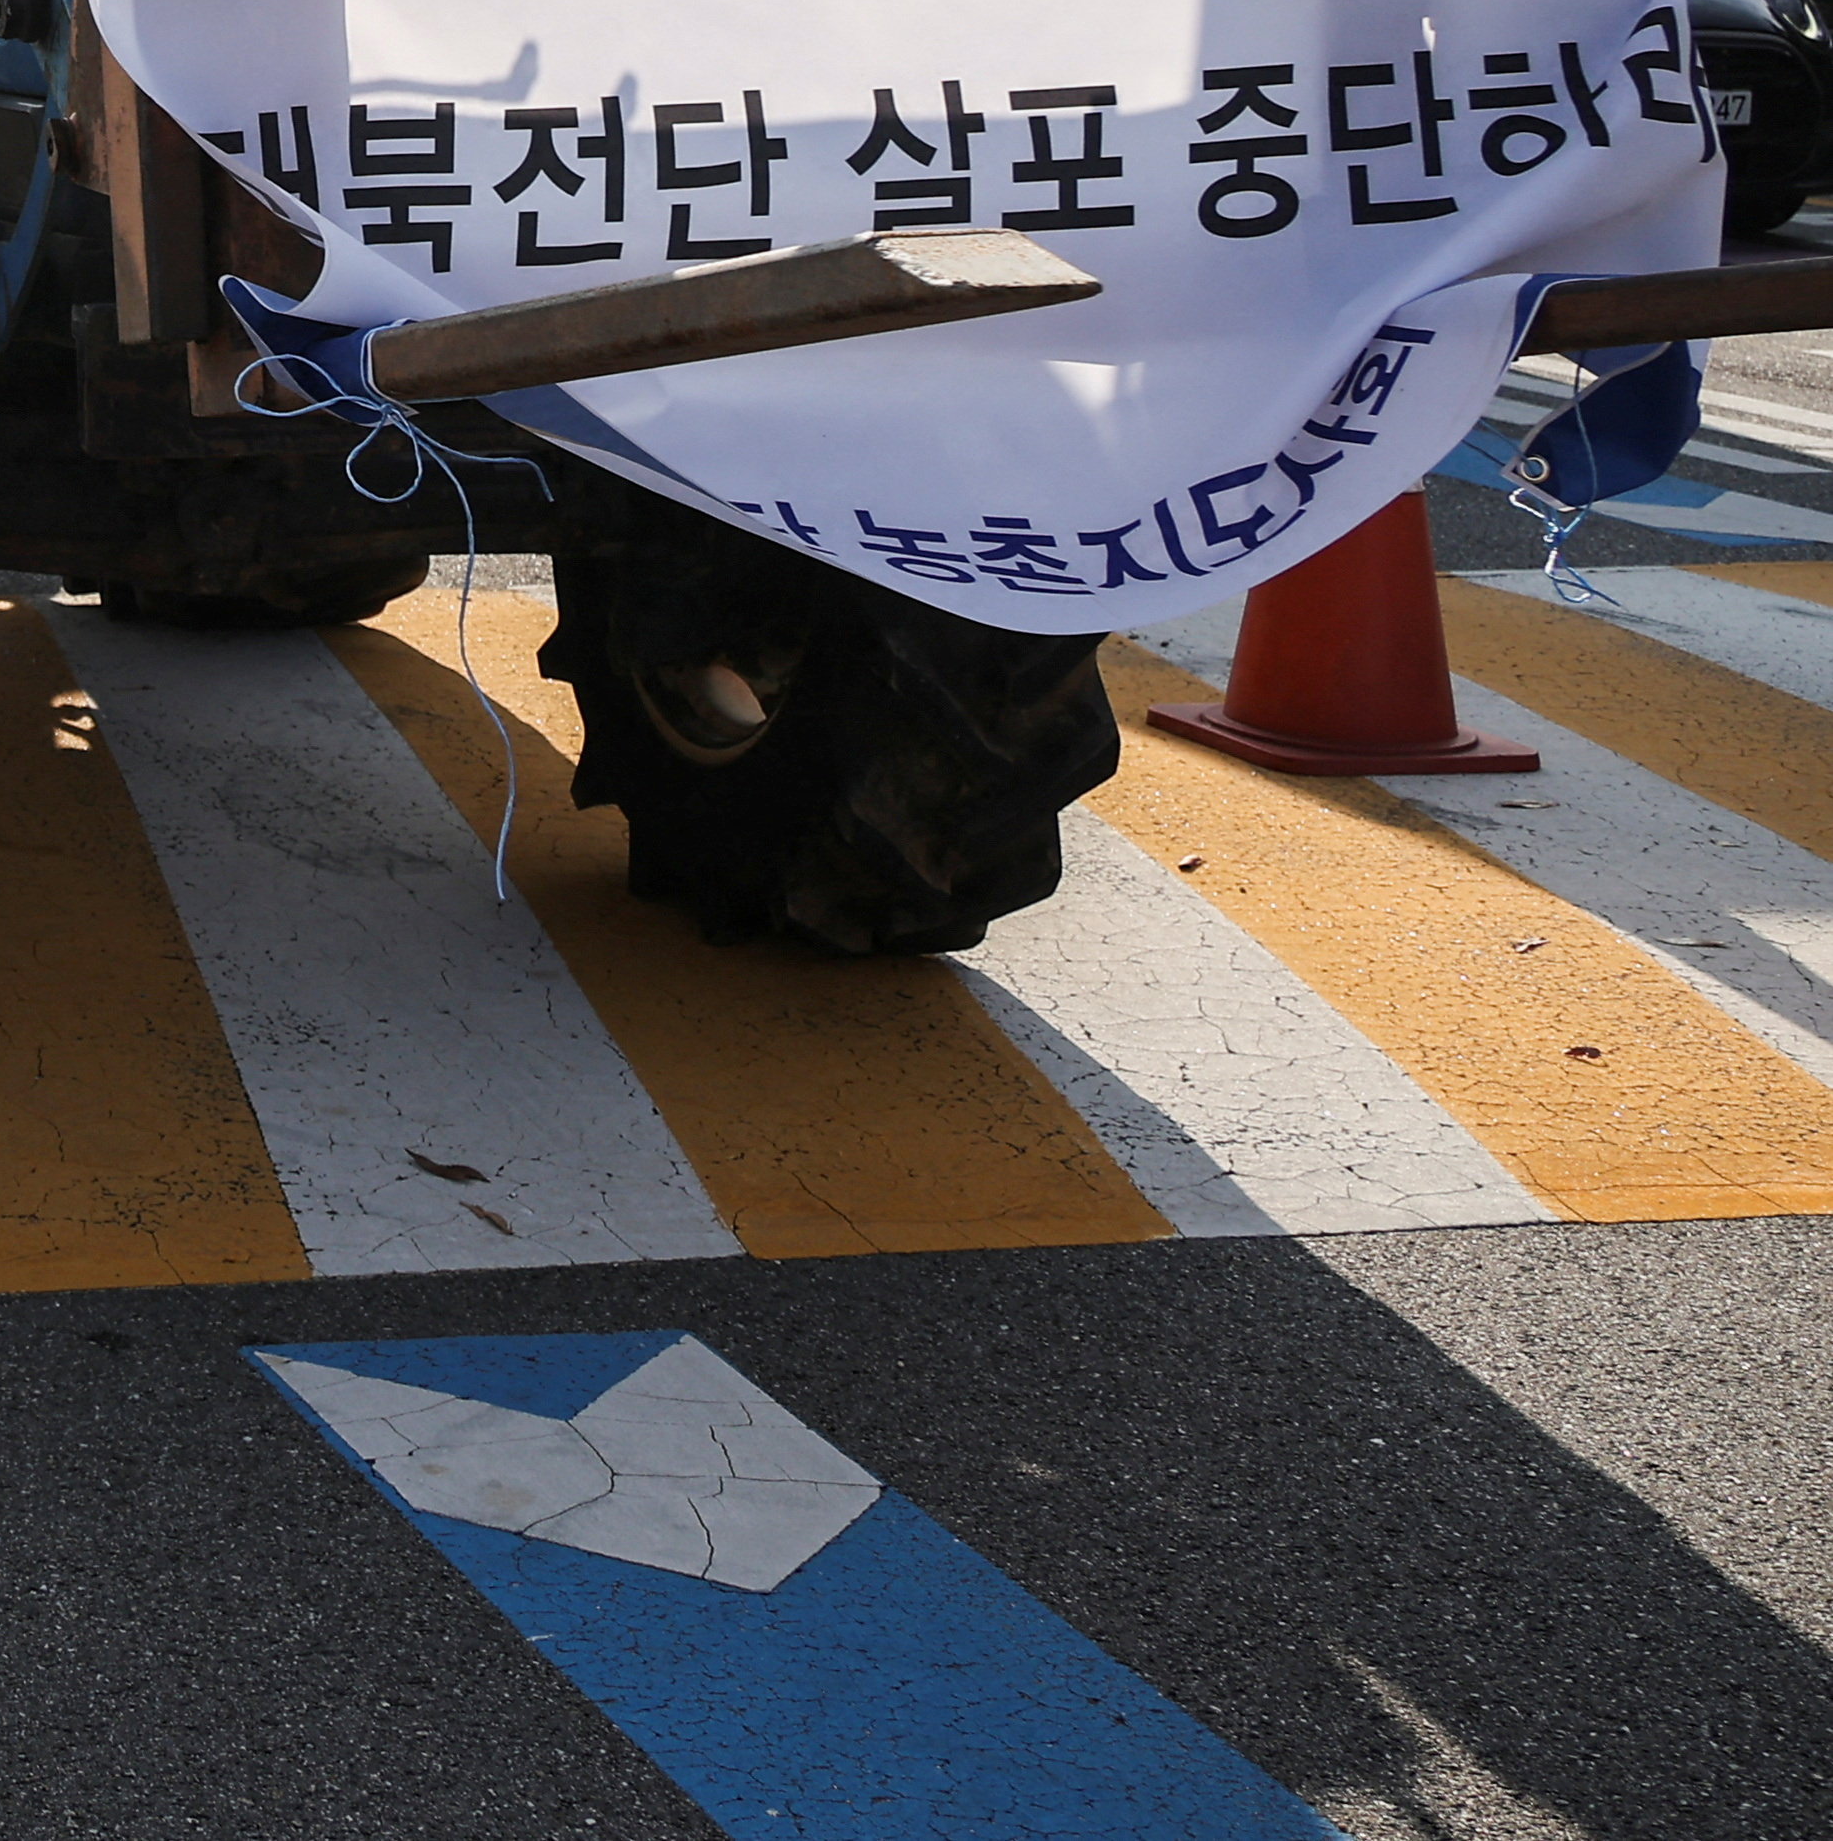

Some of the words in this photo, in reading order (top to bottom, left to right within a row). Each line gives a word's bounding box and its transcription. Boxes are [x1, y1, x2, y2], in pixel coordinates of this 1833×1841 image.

[846, 79, 1135, 232] 살포
[1188, 6, 1718, 238] 중단하라
[1711, 95, 1746, 120] 47
